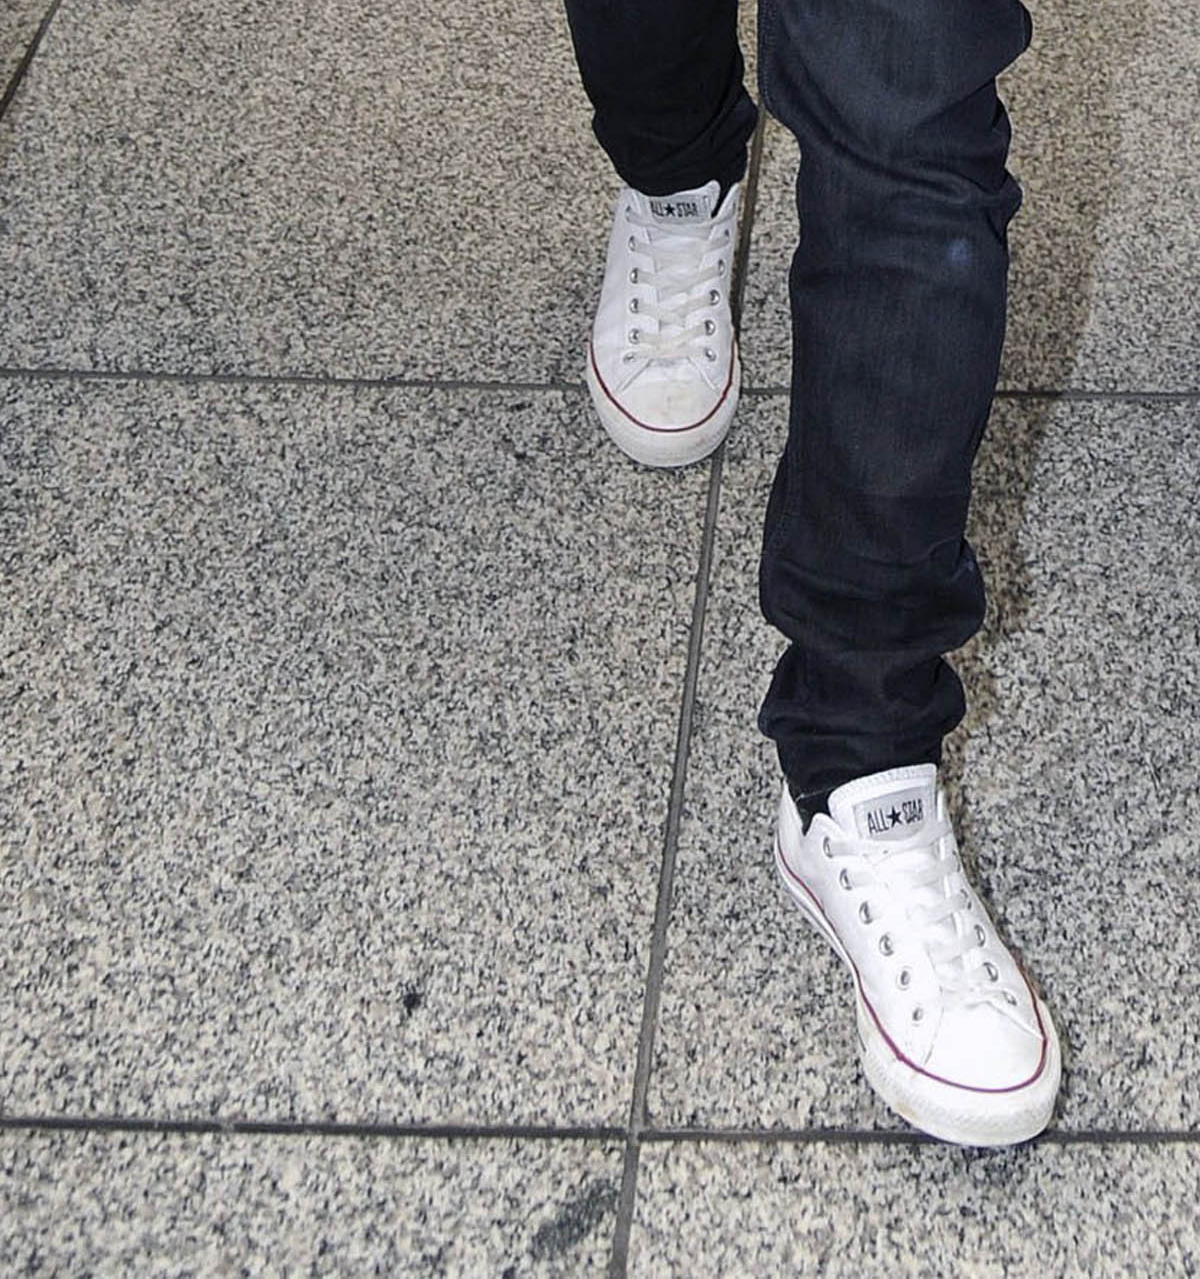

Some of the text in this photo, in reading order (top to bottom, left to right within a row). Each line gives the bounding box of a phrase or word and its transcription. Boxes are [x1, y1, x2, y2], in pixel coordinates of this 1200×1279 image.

[650, 200, 698, 218] ALL STAR
[867, 798, 924, 835] ALL STAR
